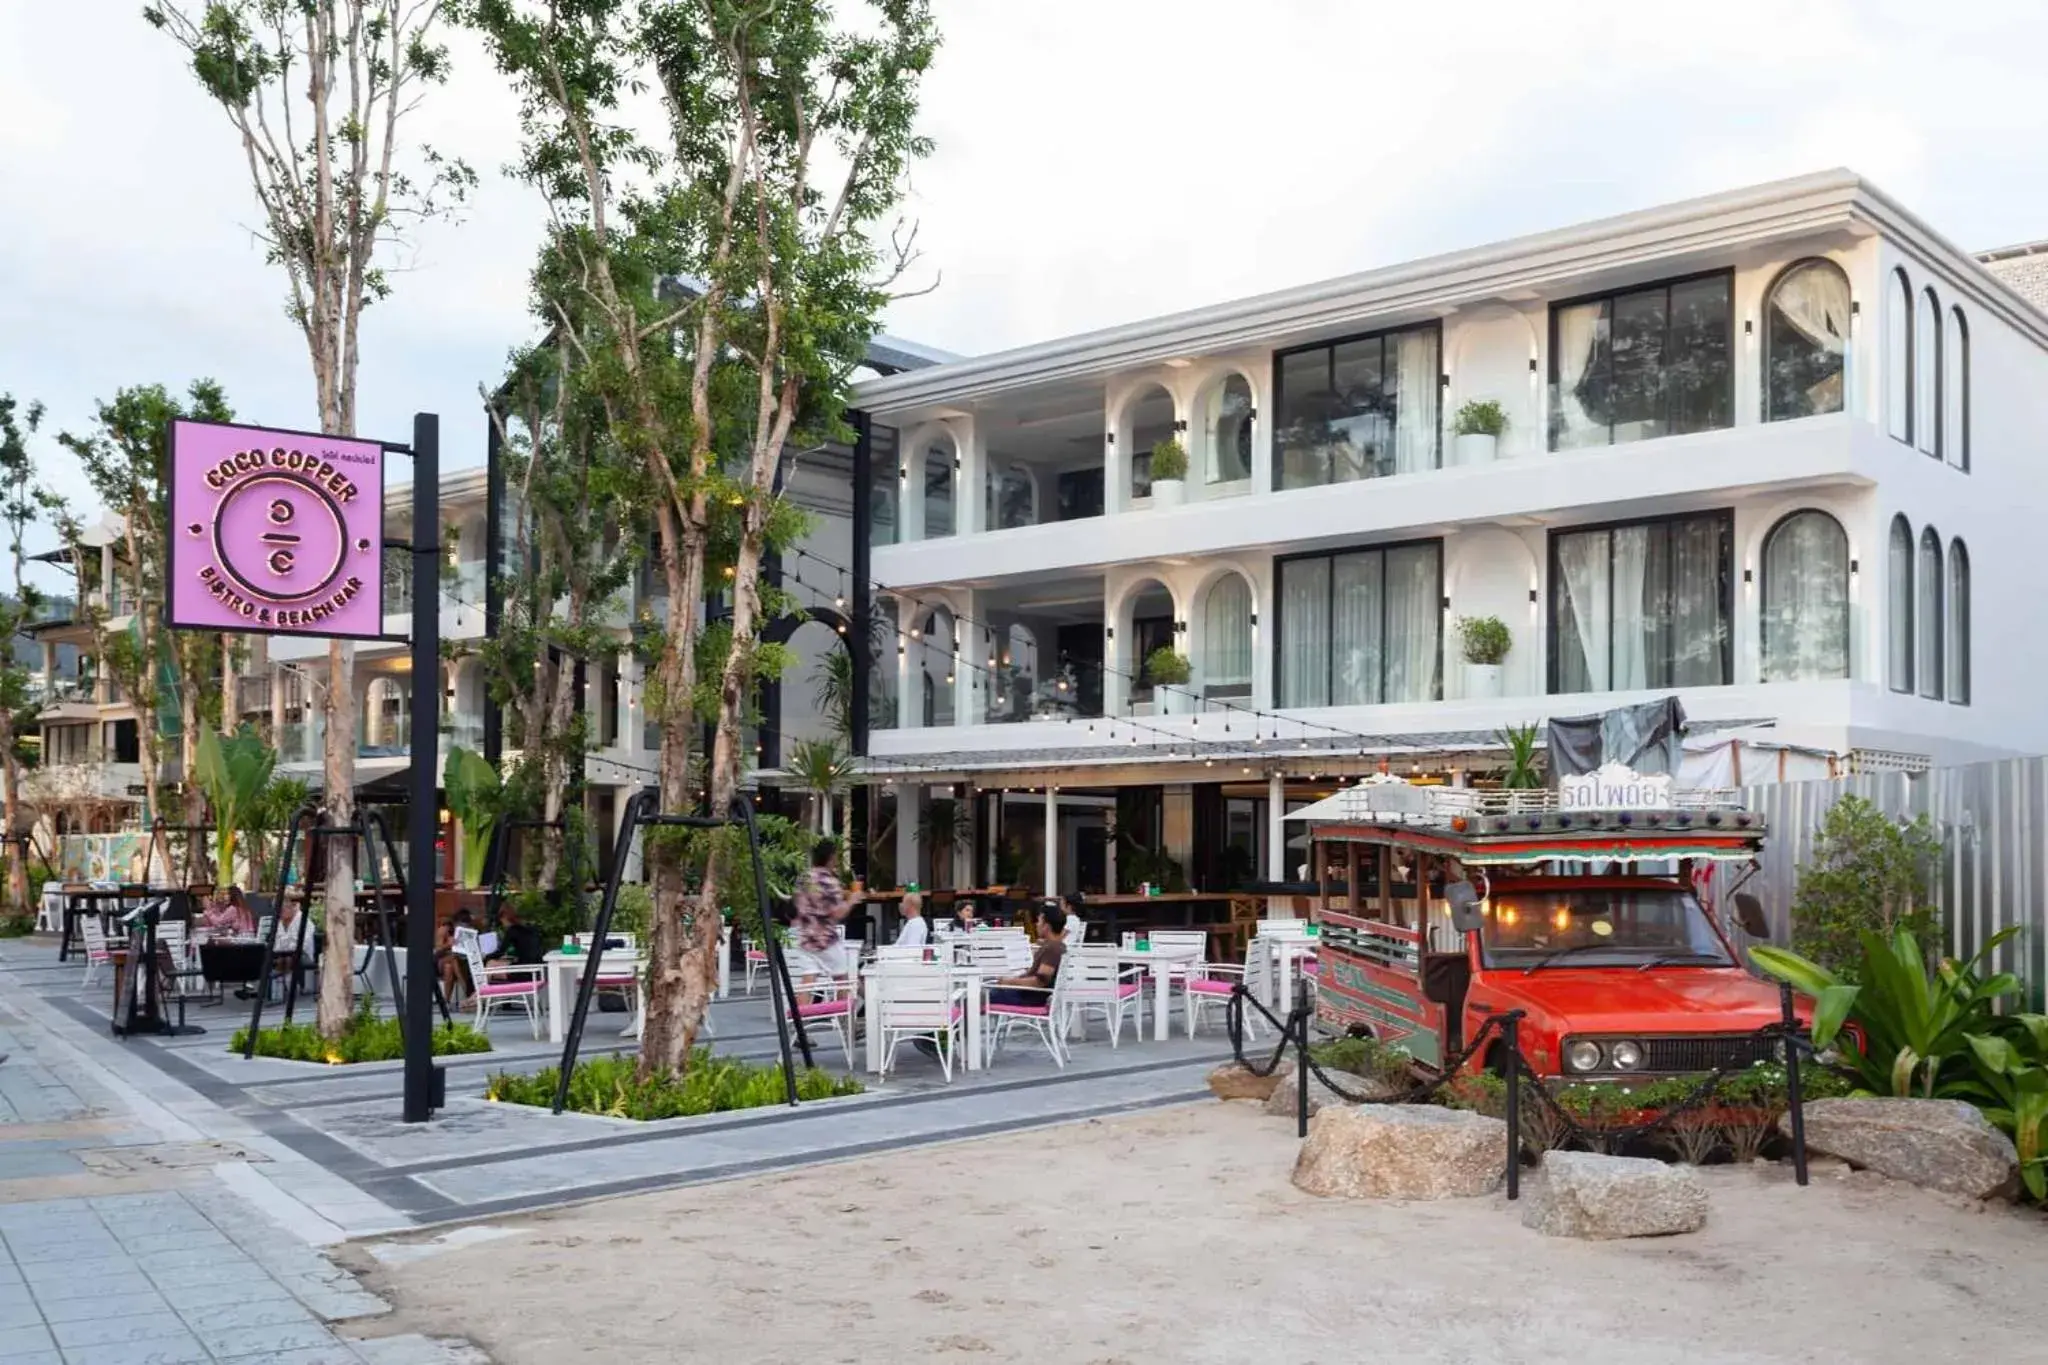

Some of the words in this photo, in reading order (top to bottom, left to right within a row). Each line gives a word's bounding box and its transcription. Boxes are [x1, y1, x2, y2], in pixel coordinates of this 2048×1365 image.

[204, 448, 266, 490] COCO
[271, 447, 359, 504] COPPER
[198, 566, 255, 616] BISTRO
[256, 608, 271, 623] &
[276, 602, 335, 626] BEACH
[333, 576, 364, 609] BAR
